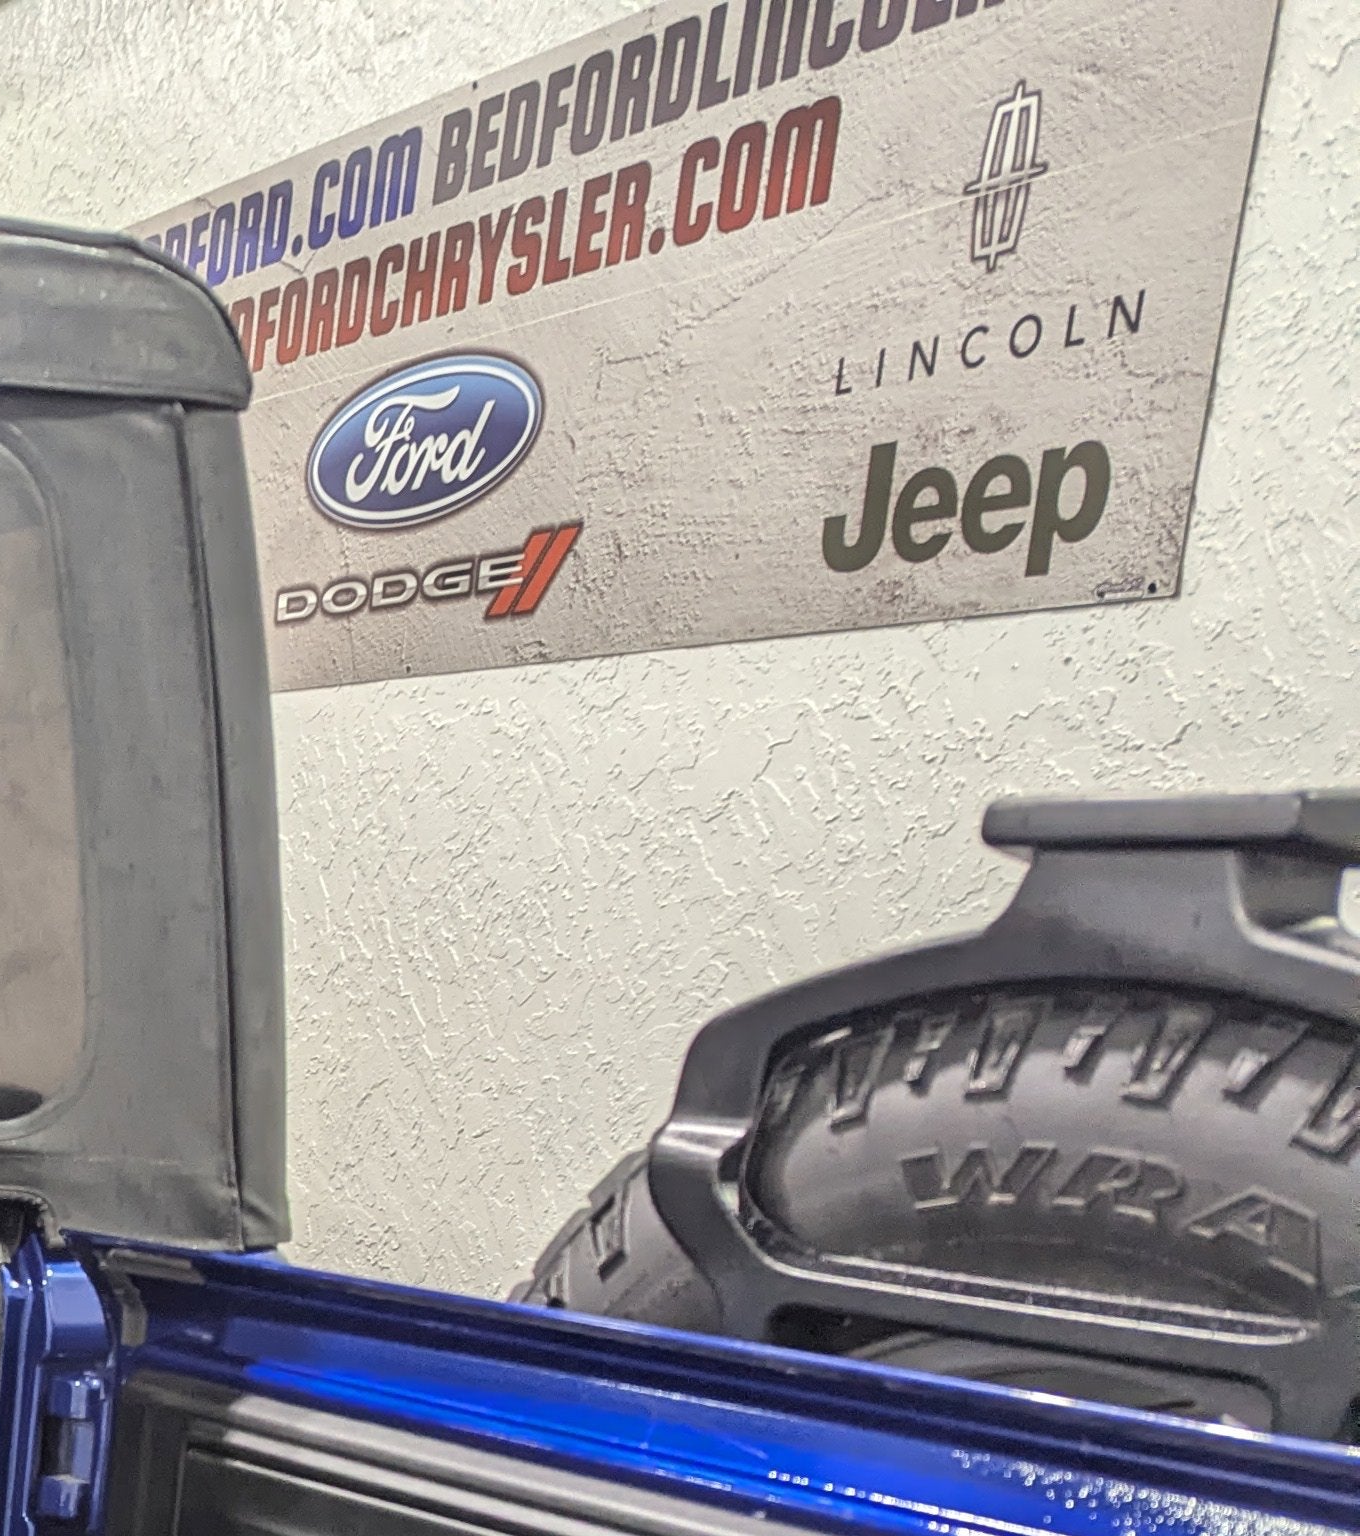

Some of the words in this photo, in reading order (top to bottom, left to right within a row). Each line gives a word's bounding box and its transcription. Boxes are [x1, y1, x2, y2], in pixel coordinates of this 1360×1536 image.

[143, 122, 423, 289] FORD.COM
[432, 0, 1006, 206] BEDFORDLINC
[225, 95, 842, 373] DFORDCHRYSLER.COM
[835, 288, 1147, 397] LINCOLN
[345, 384, 496, 503] Ford
[822, 440, 1112, 577] Jeep
[275, 551, 527, 623] DODGE
